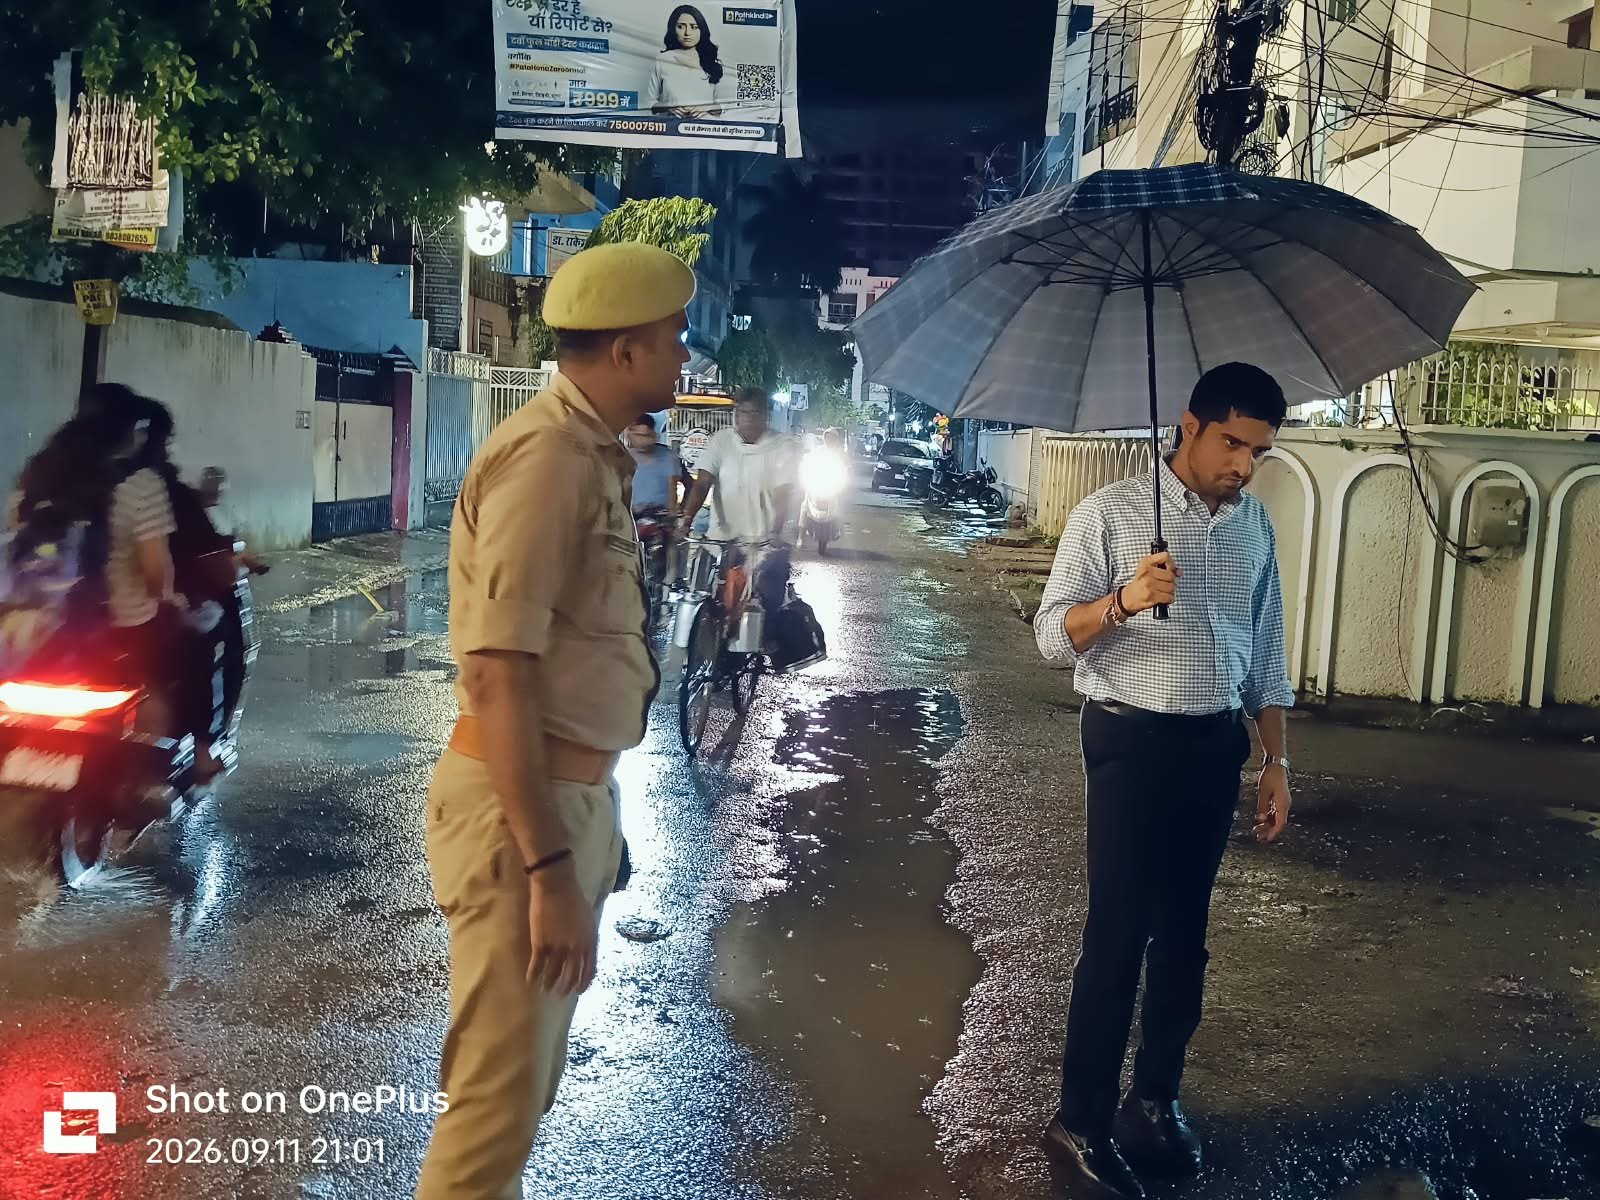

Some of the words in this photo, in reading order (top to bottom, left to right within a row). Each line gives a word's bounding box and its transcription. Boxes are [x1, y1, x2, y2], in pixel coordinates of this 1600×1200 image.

[549, 12, 591, 31] रिपोर्ट
[592, 17, 613, 33] से?
[569, 80, 587, 88] मात्र
[572, 91, 620, 109] ₹999
[620, 96, 630, 107] में
[609, 120, 667, 133] 7500075111
